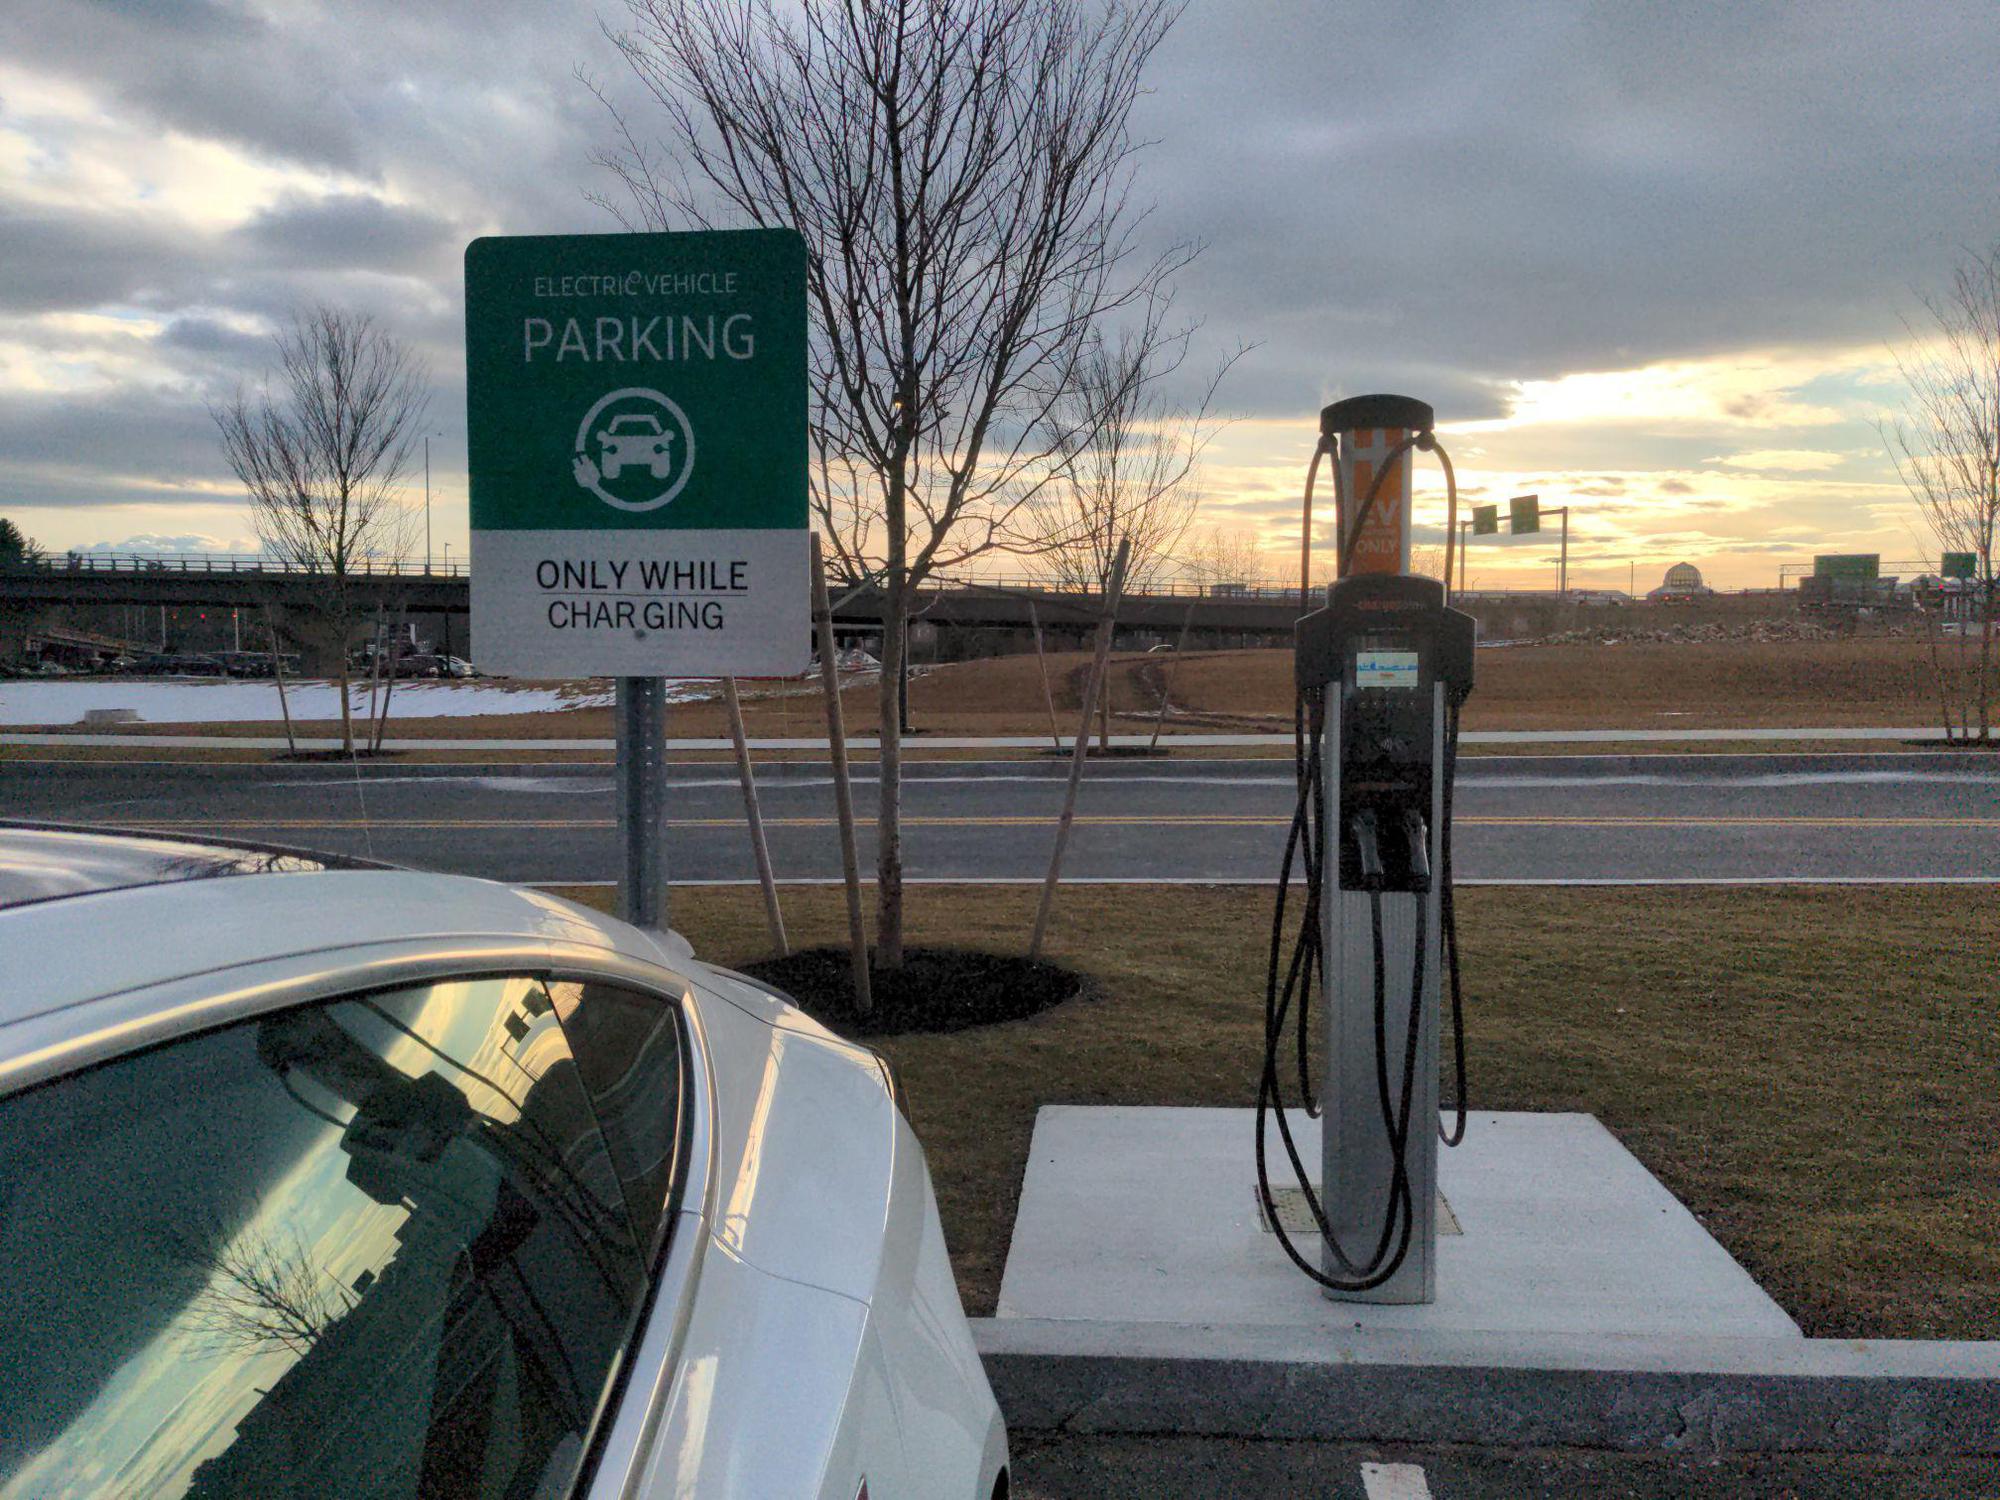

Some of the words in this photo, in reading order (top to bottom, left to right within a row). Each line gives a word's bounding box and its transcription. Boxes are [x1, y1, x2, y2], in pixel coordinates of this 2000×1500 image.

[534, 275, 638, 297] ELECTRIC
[645, 273, 737, 295] VEHICLE
[524, 314, 755, 361] PARKING
[1355, 539, 1397, 554] ONLY
[536, 560, 629, 589] ONLY
[639, 561, 748, 590] WHILE
[548, 601, 724, 630] CHARGING
